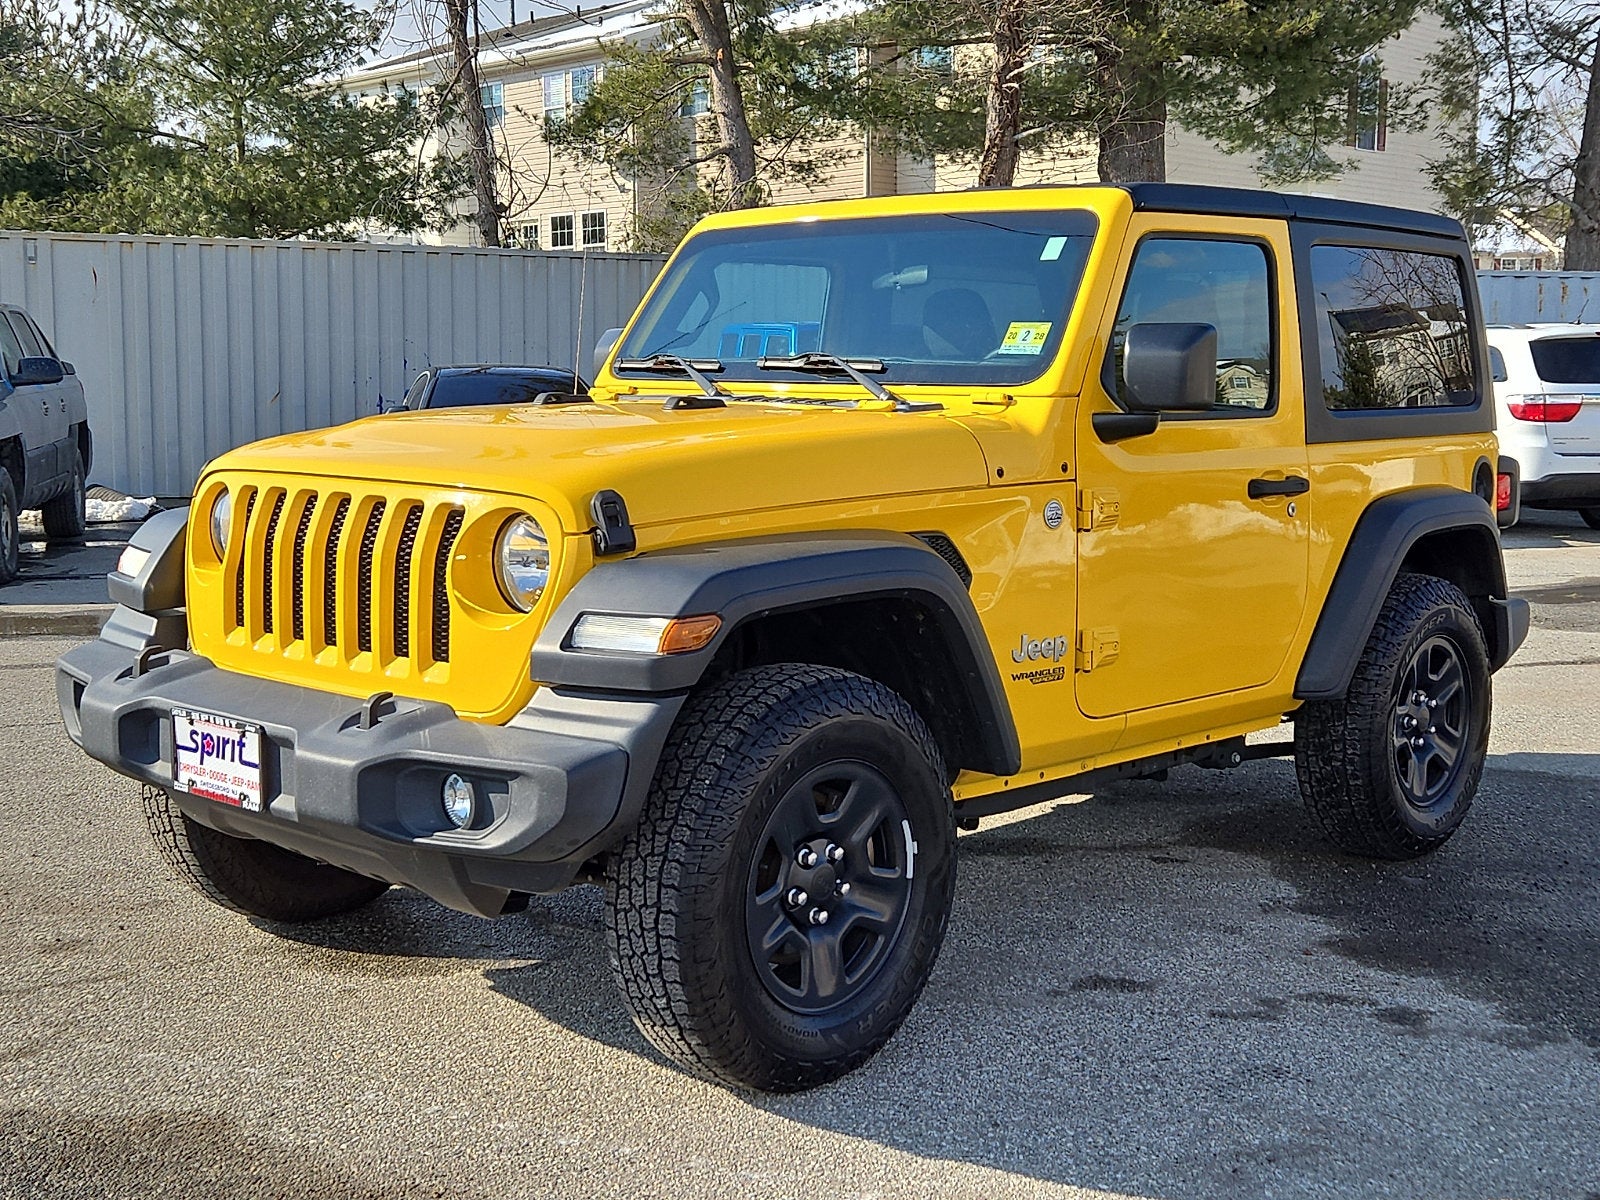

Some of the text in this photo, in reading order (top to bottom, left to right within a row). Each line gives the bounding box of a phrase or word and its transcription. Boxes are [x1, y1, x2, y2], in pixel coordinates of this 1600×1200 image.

[1007, 331, 1018, 340] 20
[1021, 330, 1031, 342] 2
[1012, 634, 1067, 663] Jeep
[1011, 666, 1065, 682] WRANGLER
[209, 769, 228, 783] DODGE
[231, 776, 245, 787] JEEP
